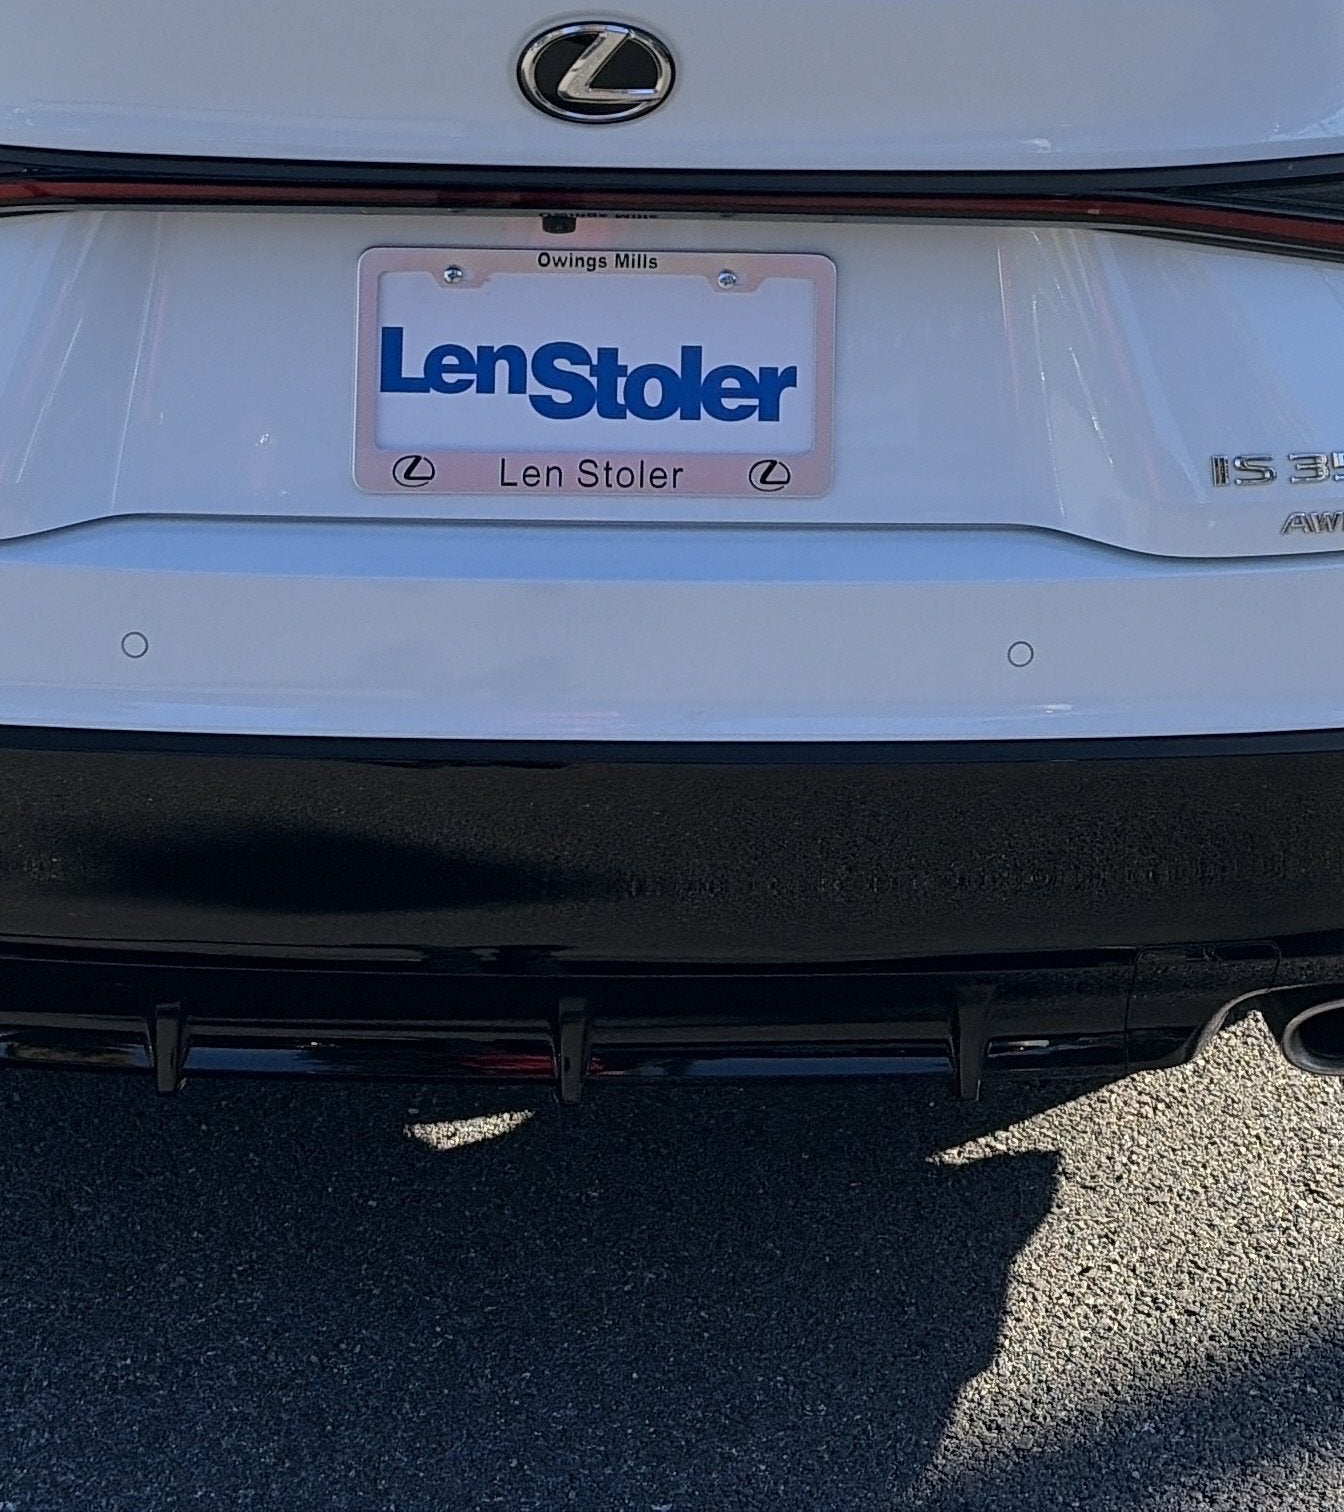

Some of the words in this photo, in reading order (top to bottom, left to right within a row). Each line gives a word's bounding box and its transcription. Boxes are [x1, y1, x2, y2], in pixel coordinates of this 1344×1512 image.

[537, 252, 608, 272] Owings
[614, 253, 658, 269] Mills
[499, 458, 563, 487] Len
[577, 459, 684, 489] Stoler
[1211, 454, 1277, 487] IS
